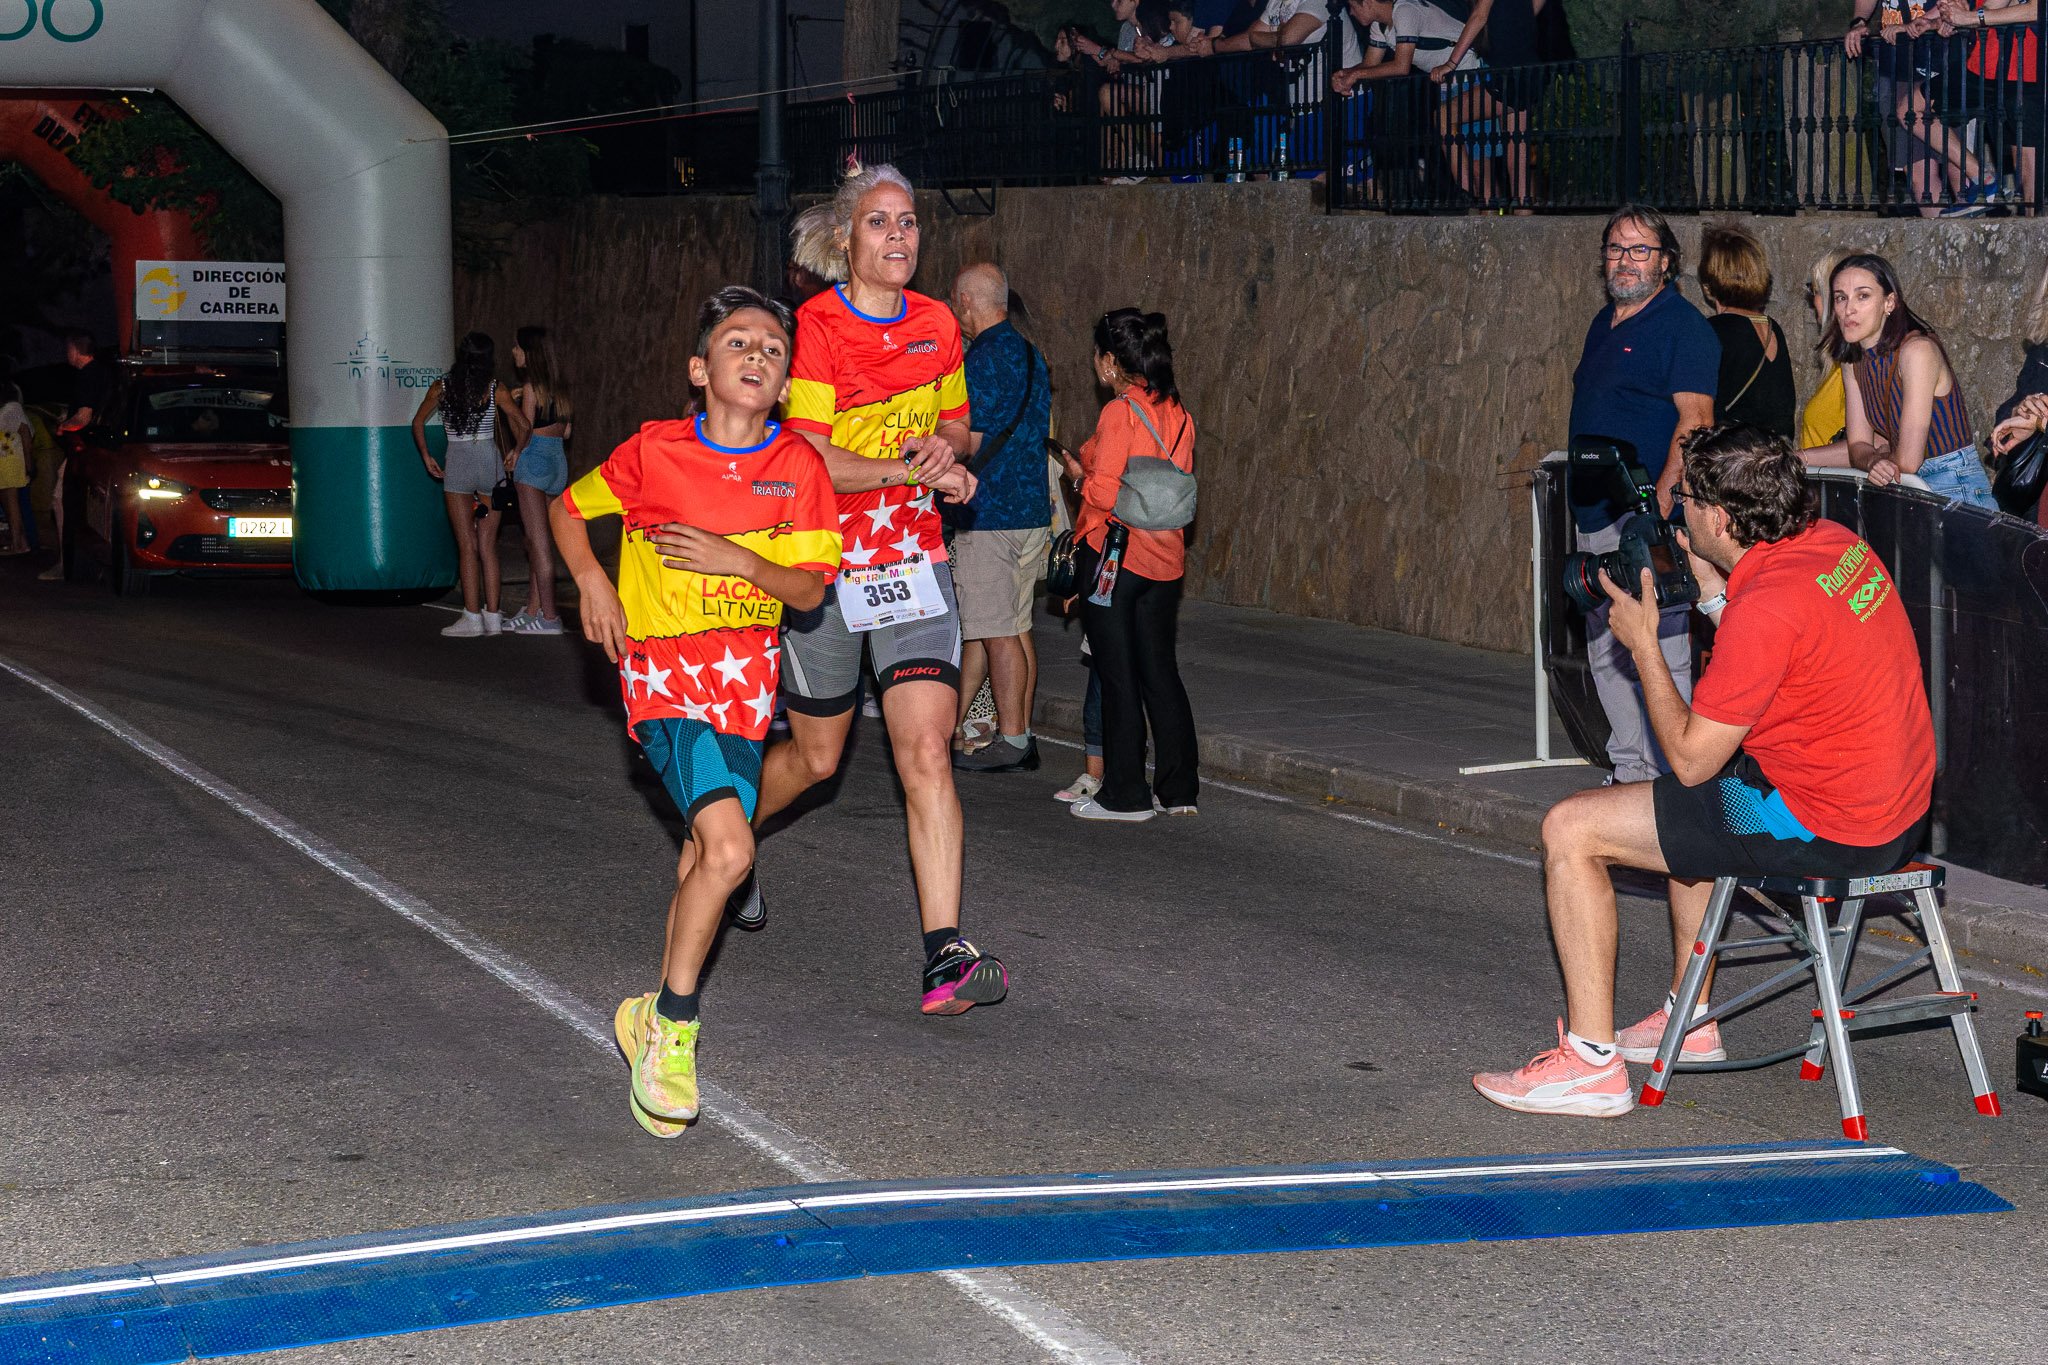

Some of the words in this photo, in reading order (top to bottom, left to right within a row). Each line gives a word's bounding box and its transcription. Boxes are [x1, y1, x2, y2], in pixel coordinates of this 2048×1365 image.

[193, 268, 285, 284] DIRECCIÓN
[229, 287, 251, 299] DE
[200, 302, 280, 315] CARRERA
[395, 375, 442, 389] TOLED
[240, 521, 277, 534] 0282
[863, 580, 911, 607] 353
[702, 598, 777, 620] LITNER
[892, 666, 942, 681] HOKO
